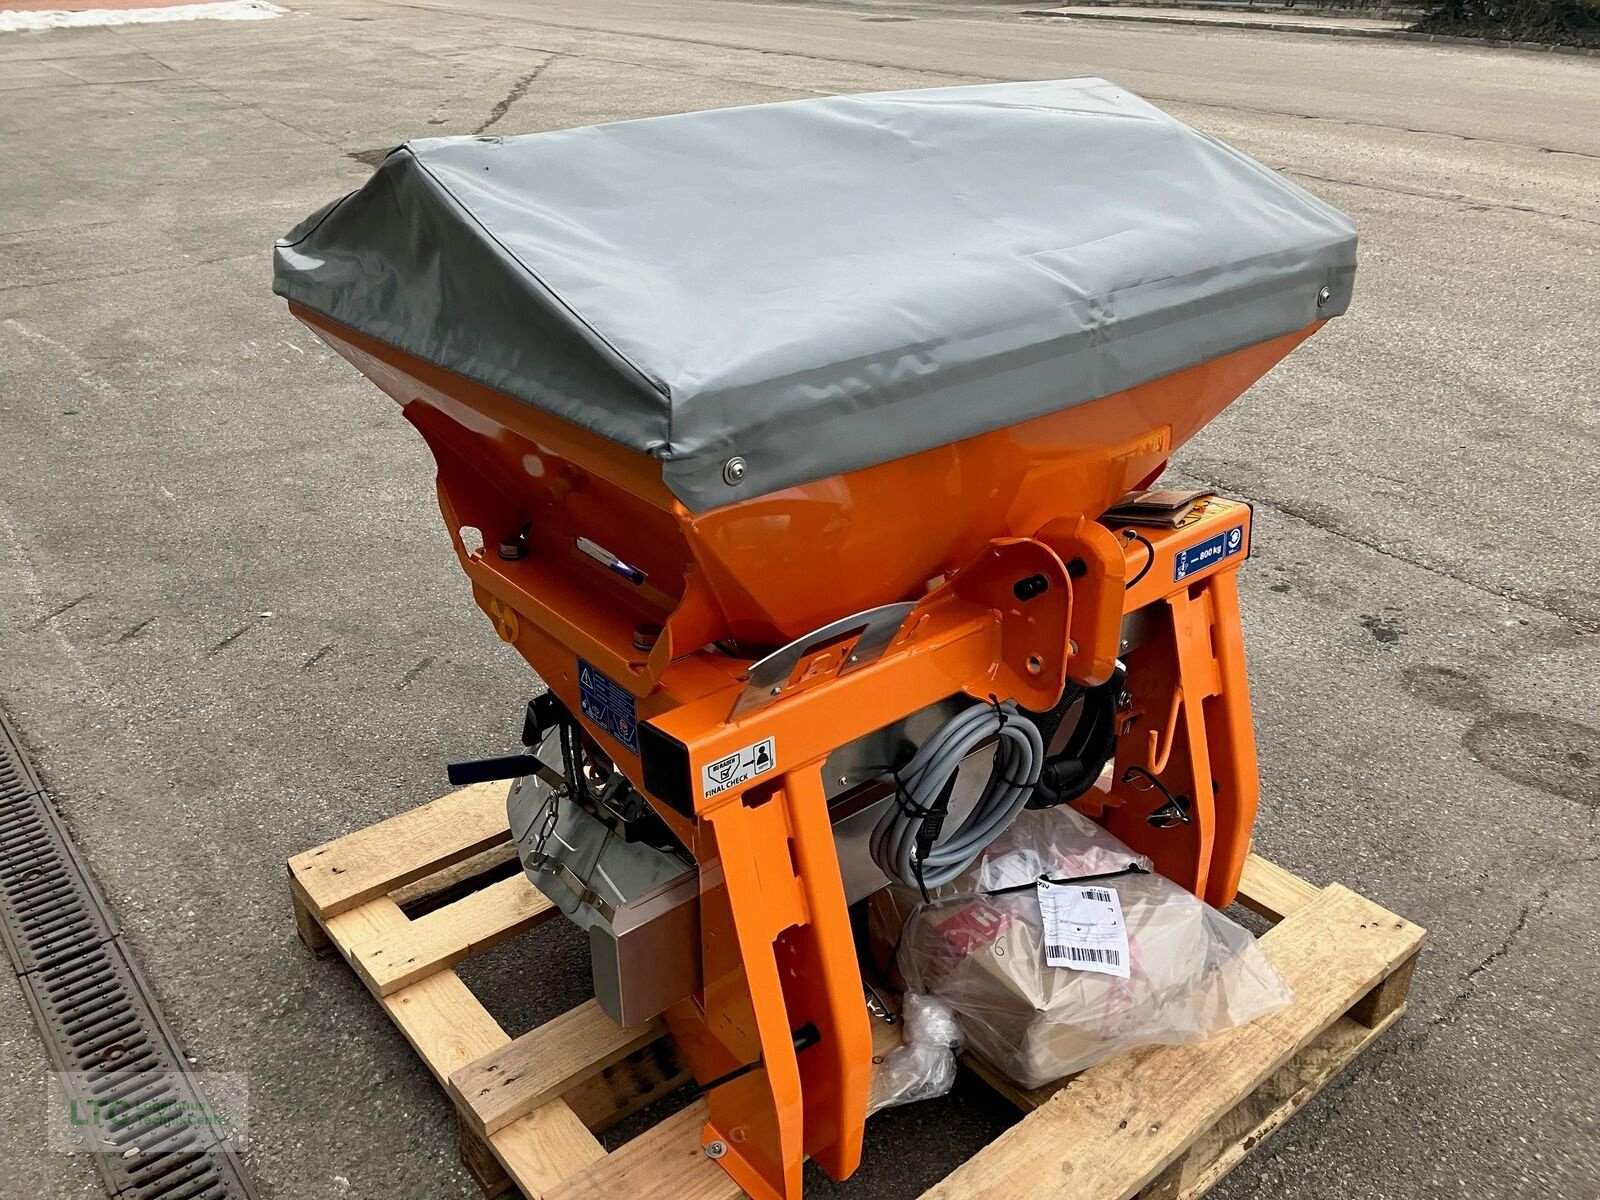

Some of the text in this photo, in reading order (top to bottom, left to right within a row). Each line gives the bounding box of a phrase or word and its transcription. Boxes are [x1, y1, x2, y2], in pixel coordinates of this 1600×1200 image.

[1200, 548, 1212, 560] 800
[1213, 545, 1222, 554] kg
[705, 773, 748, 798] FINAL CHECK
[994, 935, 1007, 957] 6
